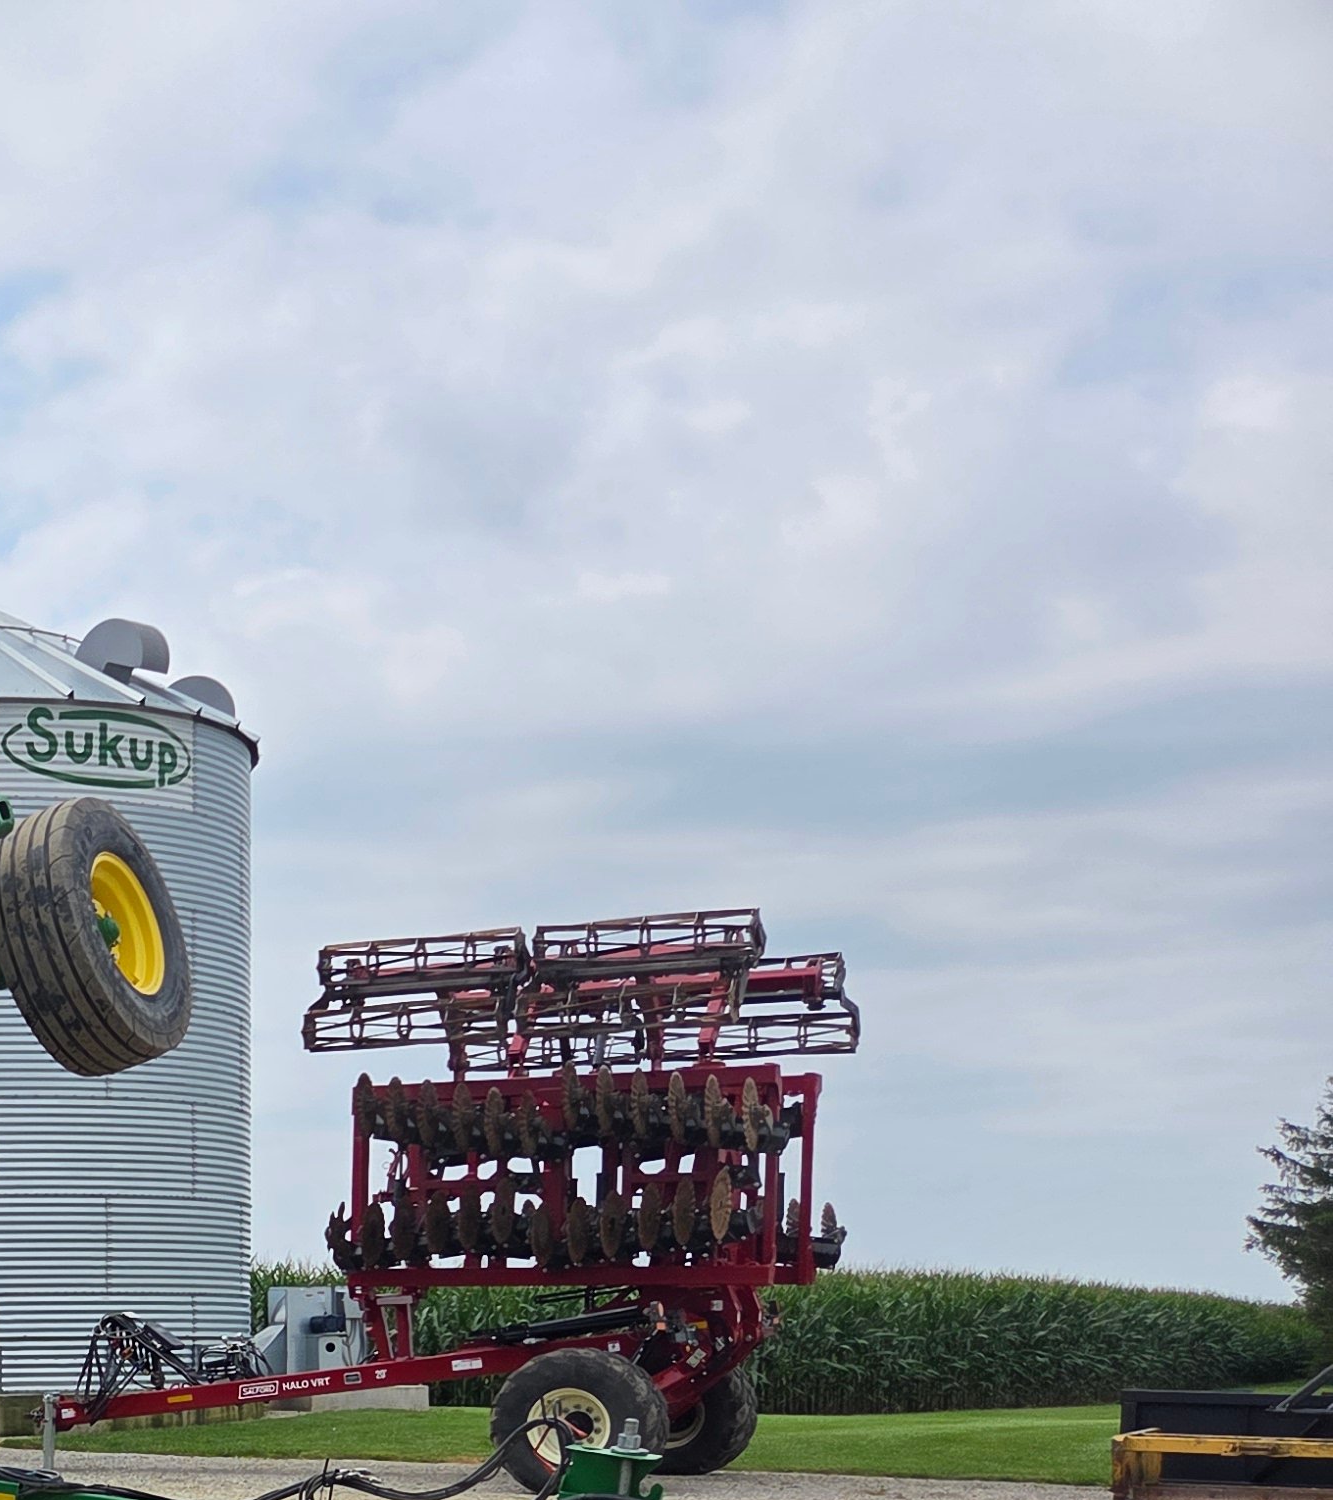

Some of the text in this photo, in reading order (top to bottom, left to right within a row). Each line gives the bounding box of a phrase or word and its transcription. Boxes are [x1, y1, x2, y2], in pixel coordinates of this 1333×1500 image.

[25, 706, 178, 788] Sukup
[242, 1384, 276, 1396] SALFORD
[282, 1380, 309, 1390] HALO
[310, 1376, 331, 1387] VRT
